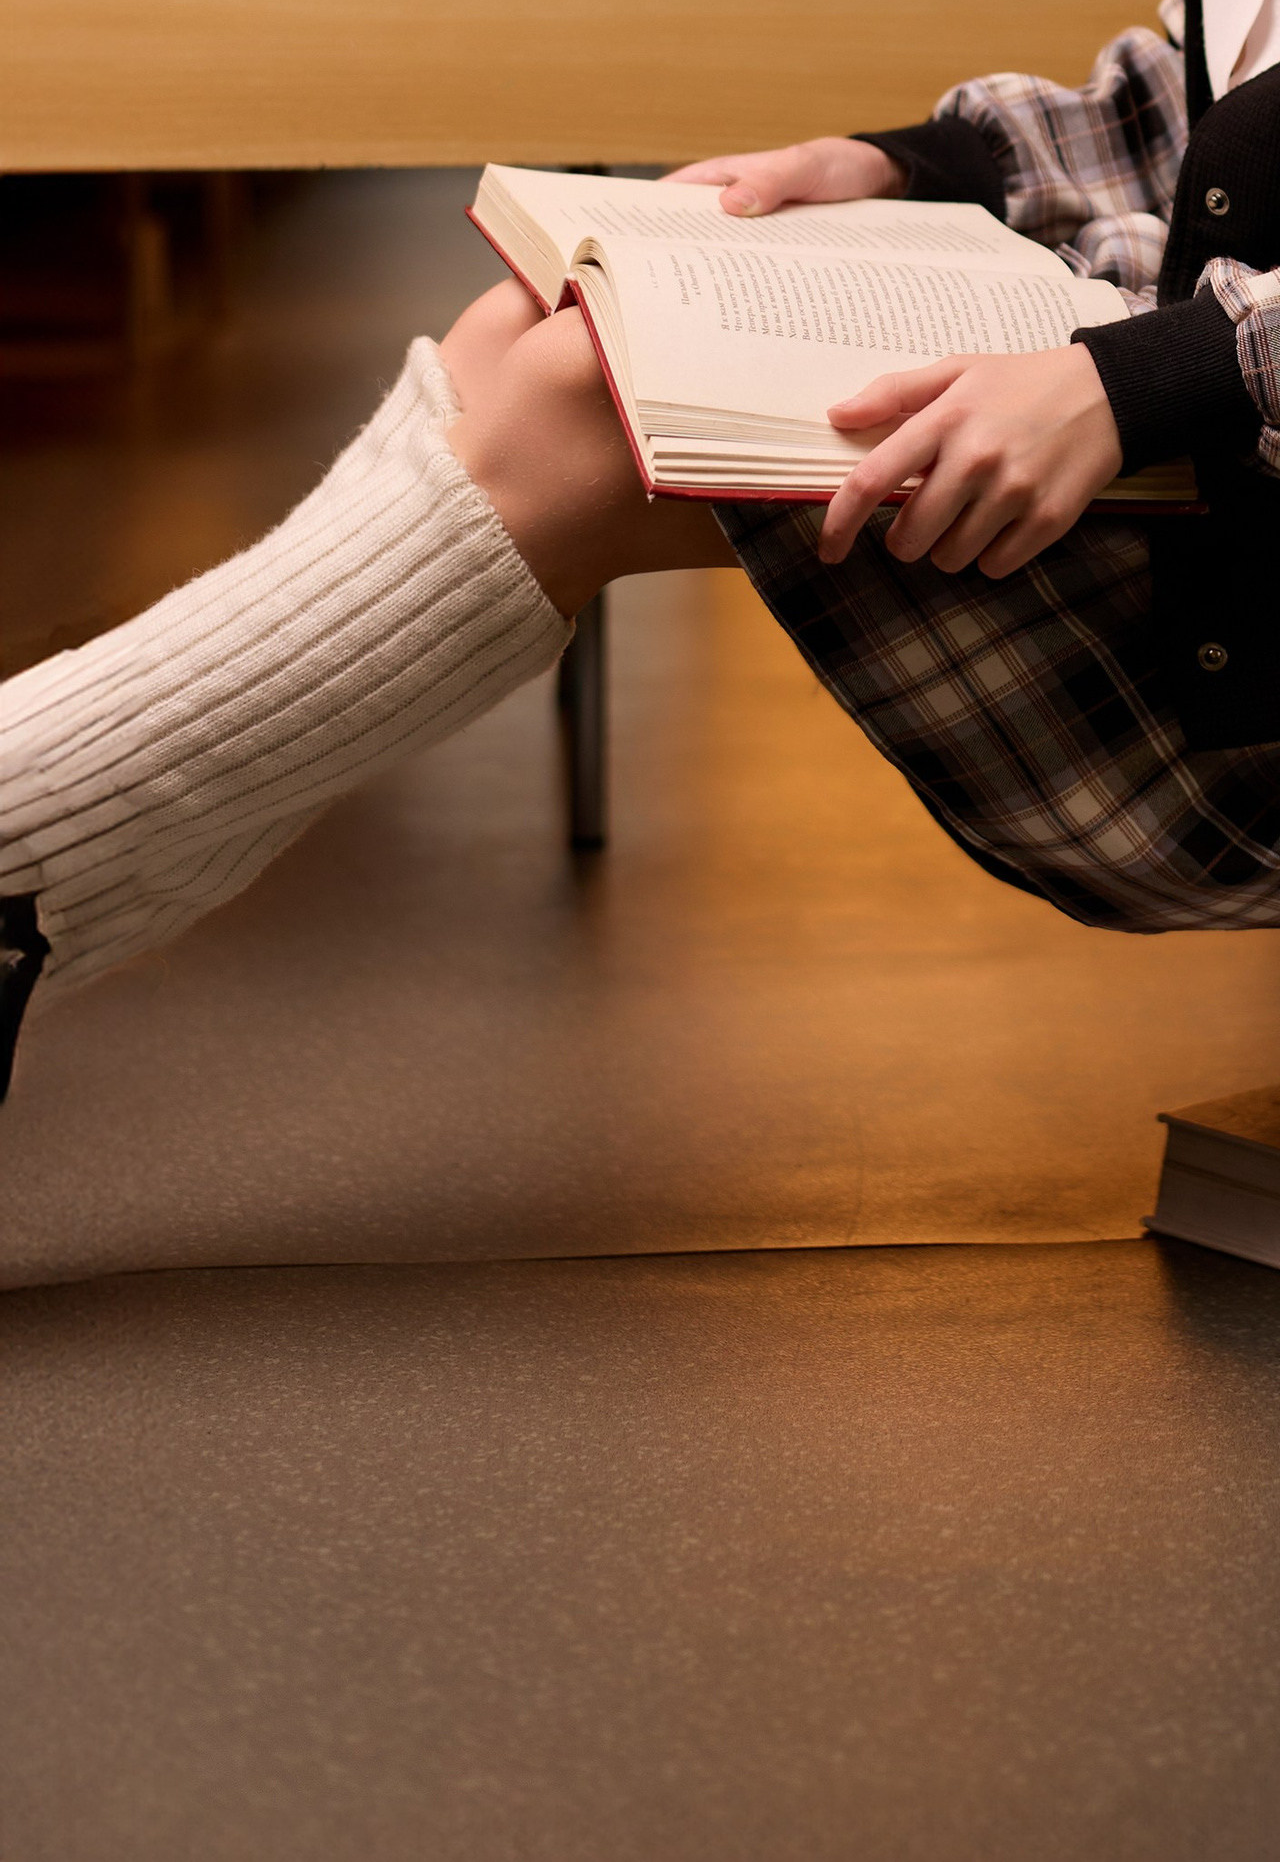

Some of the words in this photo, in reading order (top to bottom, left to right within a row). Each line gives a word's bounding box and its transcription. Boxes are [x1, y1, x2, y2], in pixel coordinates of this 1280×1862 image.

[679, 278, 690, 305] Письмо
[773, 268, 786, 294] жалости
[802, 277, 814, 303] молчать
[879, 278, 892, 305] слышать
[714, 284, 723, 301] пишу
[730, 294, 738, 308] могу
[750, 273, 767, 313] презреньем
[765, 286, 776, 303] моей
[792, 284, 805, 316] оставите
[818, 284, 828, 304] моего
[845, 289, 857, 317] надежду
[858, 288, 866, 302] хоть
[868, 288, 880, 311] нашей
[908, 290, 920, 311] думать
[783, 295, 793, 318] каплю
[835, 297, 844, 320] узнали
[926, 305, 935, 321] ночь
[946, 293, 960, 320] деревне
[961, 299, 968, 309] мы
[975, 303, 988, 320] рады
[992, 297, 1007, 329] посетили
[1019, 301, 1029, 319] знала
[734, 317, 743, 331] Что
[747, 306, 757, 333] Теперь,
[761, 315, 770, 335] Меня
[813, 311, 824, 342] Сначала
[824, 306, 837, 344] Поверьте:
[863, 305, 876, 329] редко,
[888, 305, 898, 330] только
[904, 316, 913, 337] слово
[916, 314, 928, 340] думать,
[965, 311, 976, 334] ничем
[1008, 304, 1021, 336] забытого
[775, 325, 784, 337] Но
[789, 320, 797, 338] Хоть
[802, 329, 810, 340] Вы
[855, 325, 864, 347] Когда
[878, 313, 890, 343] деревне
[942, 315, 953, 345] говорят,
[982, 329, 990, 343] вам
[1003, 331, 1010, 341] вы
[842, 334, 850, 346] Вы
[869, 330, 877, 349] Хоть
[892, 333, 903, 352] Чтоб
[909, 339, 917, 354] Вам
[920, 342, 930, 355] Всё
[933, 330, 942, 349] день
